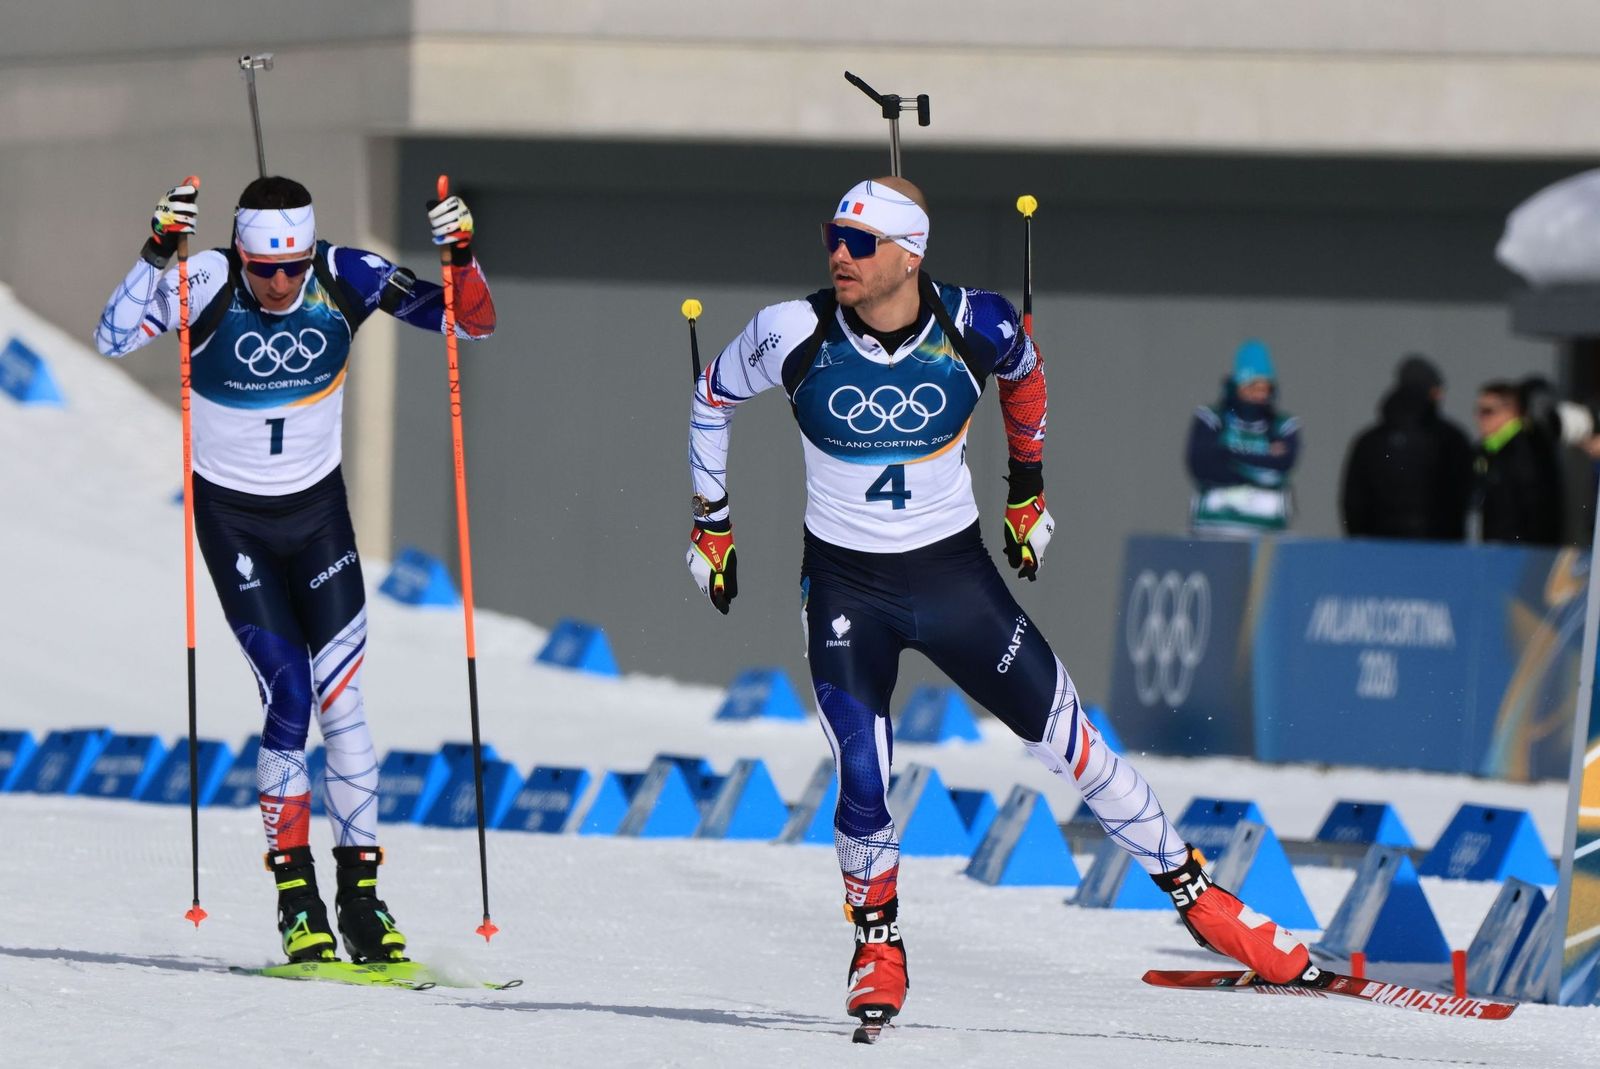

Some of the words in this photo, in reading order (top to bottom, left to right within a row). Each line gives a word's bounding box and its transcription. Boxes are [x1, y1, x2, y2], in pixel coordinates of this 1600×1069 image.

[170, 273, 201, 296] CFT
[748, 338, 769, 367] CRAFT
[224, 380, 266, 391] MILANO
[267, 379, 311, 391] CORTINA
[265, 418, 286, 456] 1
[823, 437, 872, 448] MILANO
[874, 439, 928, 448] CORTINA
[931, 433, 953, 444] 2026
[865, 464, 912, 510] 4
[309, 554, 350, 589] CRAFT
[239, 578, 261, 592] FRANCE
[826, 639, 851, 648] FRANCE
[997, 625, 1025, 674] CRAFT
